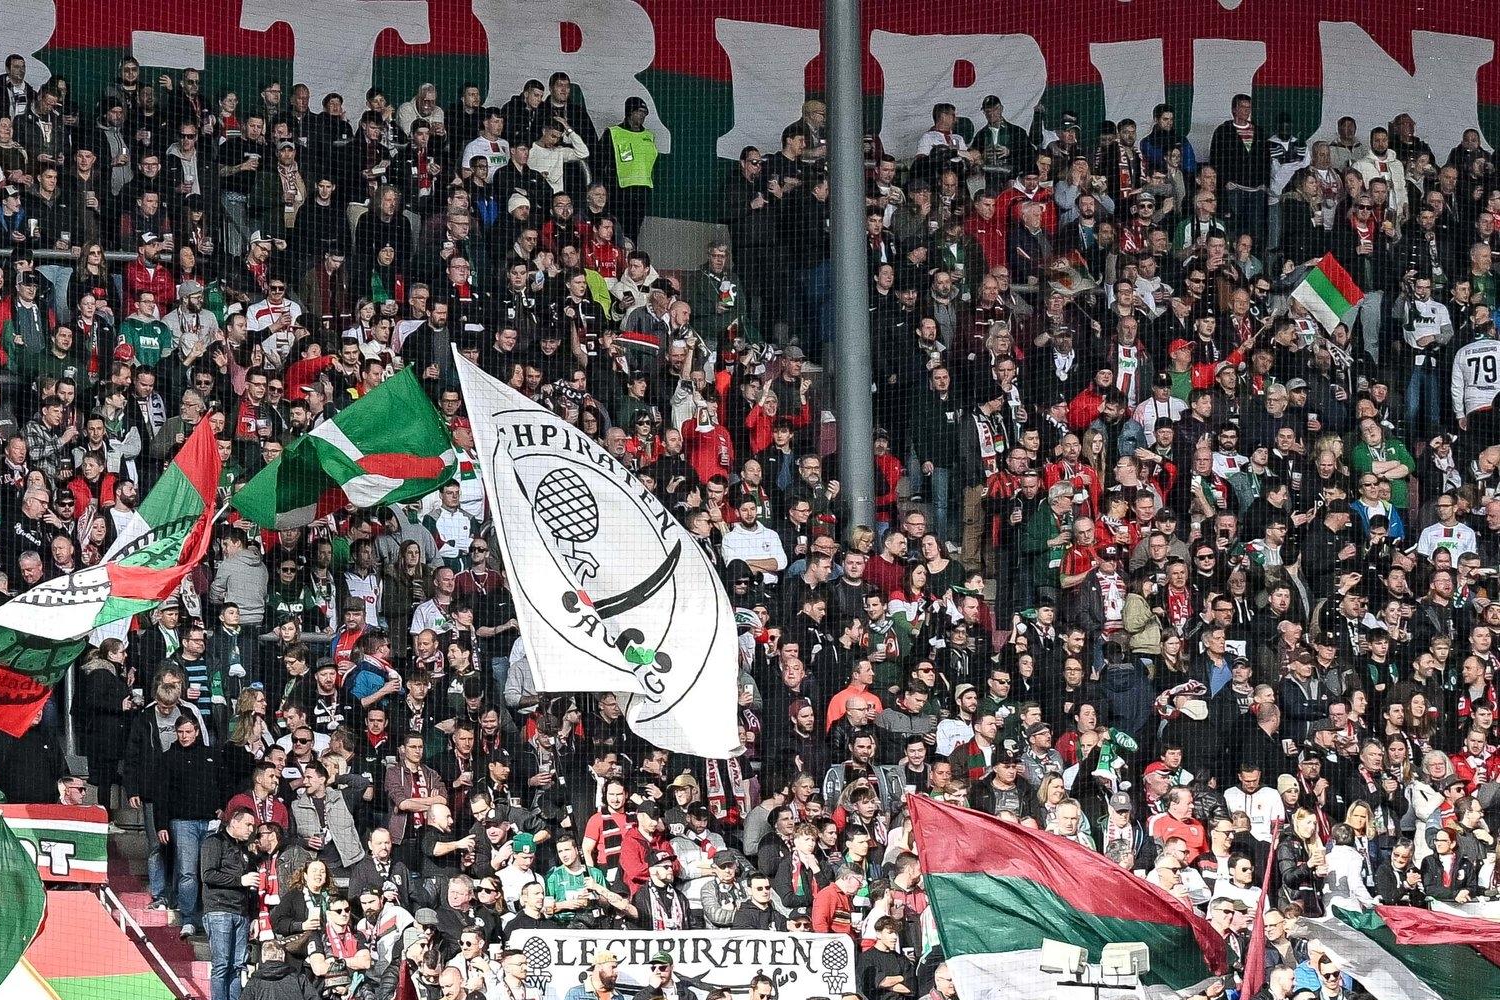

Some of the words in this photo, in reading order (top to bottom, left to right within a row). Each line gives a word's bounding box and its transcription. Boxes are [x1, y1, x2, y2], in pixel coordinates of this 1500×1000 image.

[1466, 354, 1498, 385] 79
[498, 423, 682, 541] HPIRATEN
[553, 936, 817, 973] LECHPIRATEN
